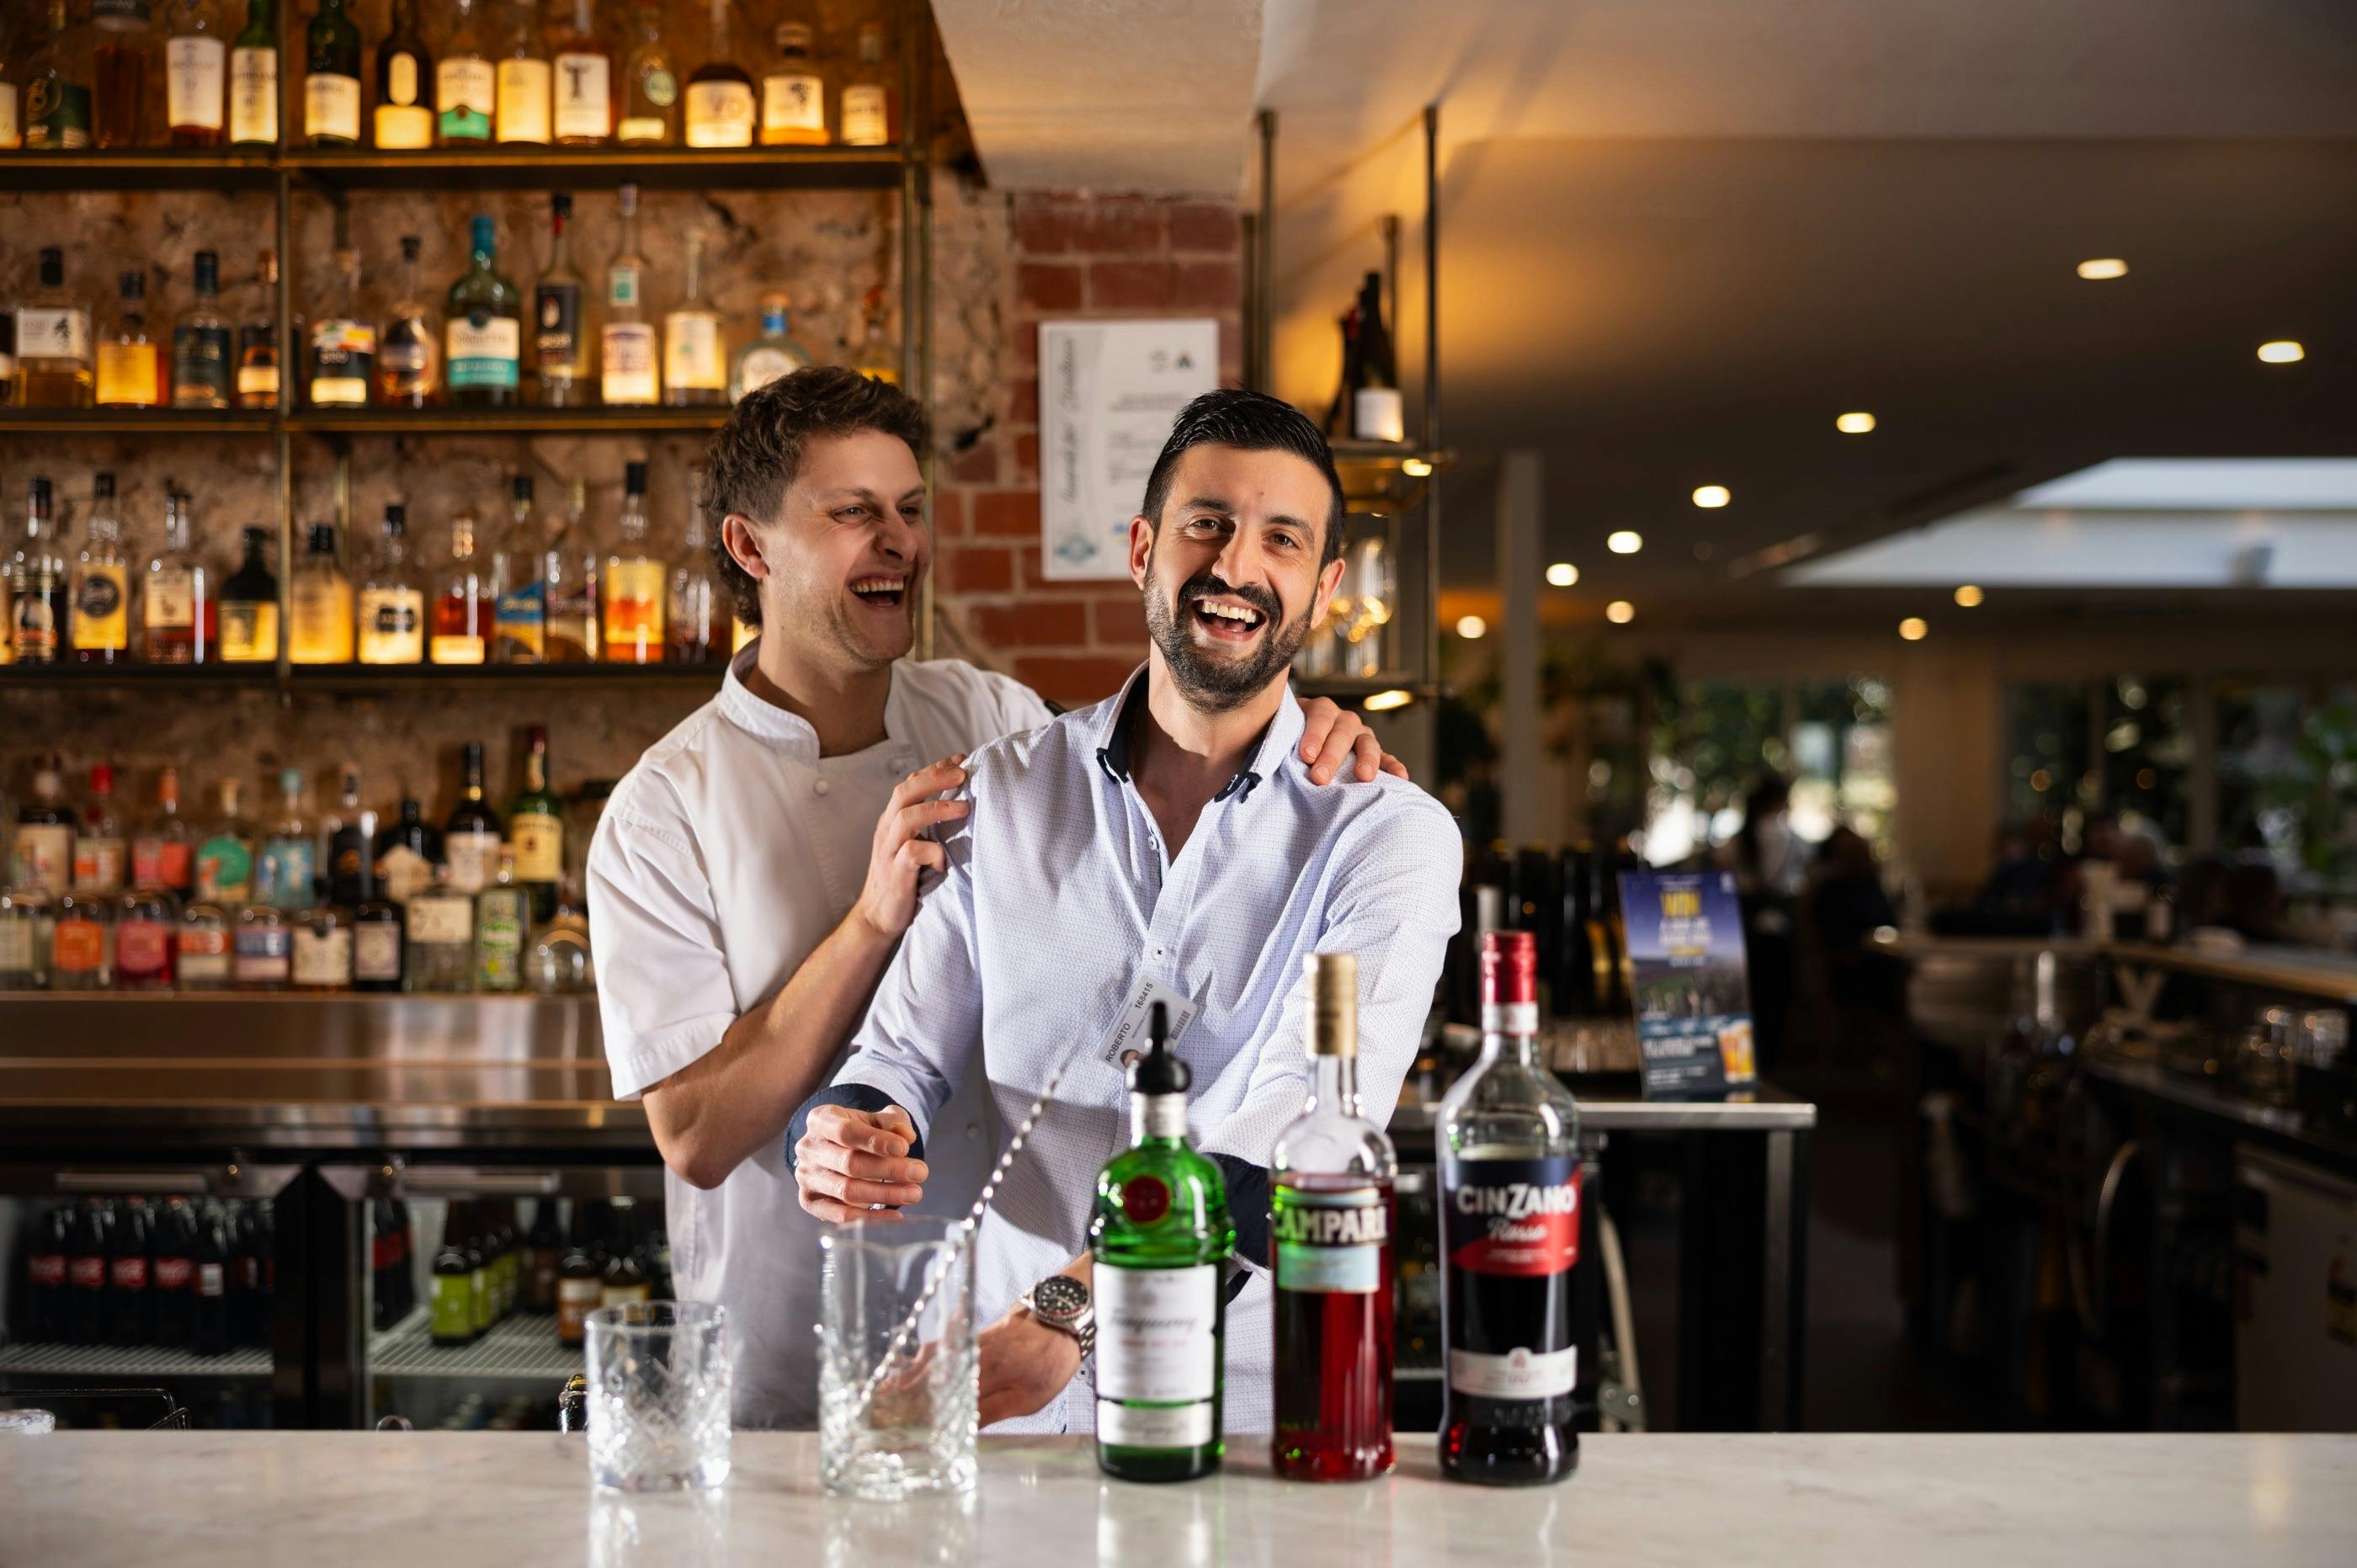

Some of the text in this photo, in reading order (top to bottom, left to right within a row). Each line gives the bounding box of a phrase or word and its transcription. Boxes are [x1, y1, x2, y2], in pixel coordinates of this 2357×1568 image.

[1135, 982, 1153, 1009] 168415
[1105, 1023, 1131, 1062] ROBERTO
[1455, 1183, 1577, 1219] CINZANO
[1487, 1217, 1549, 1241] Rosso
